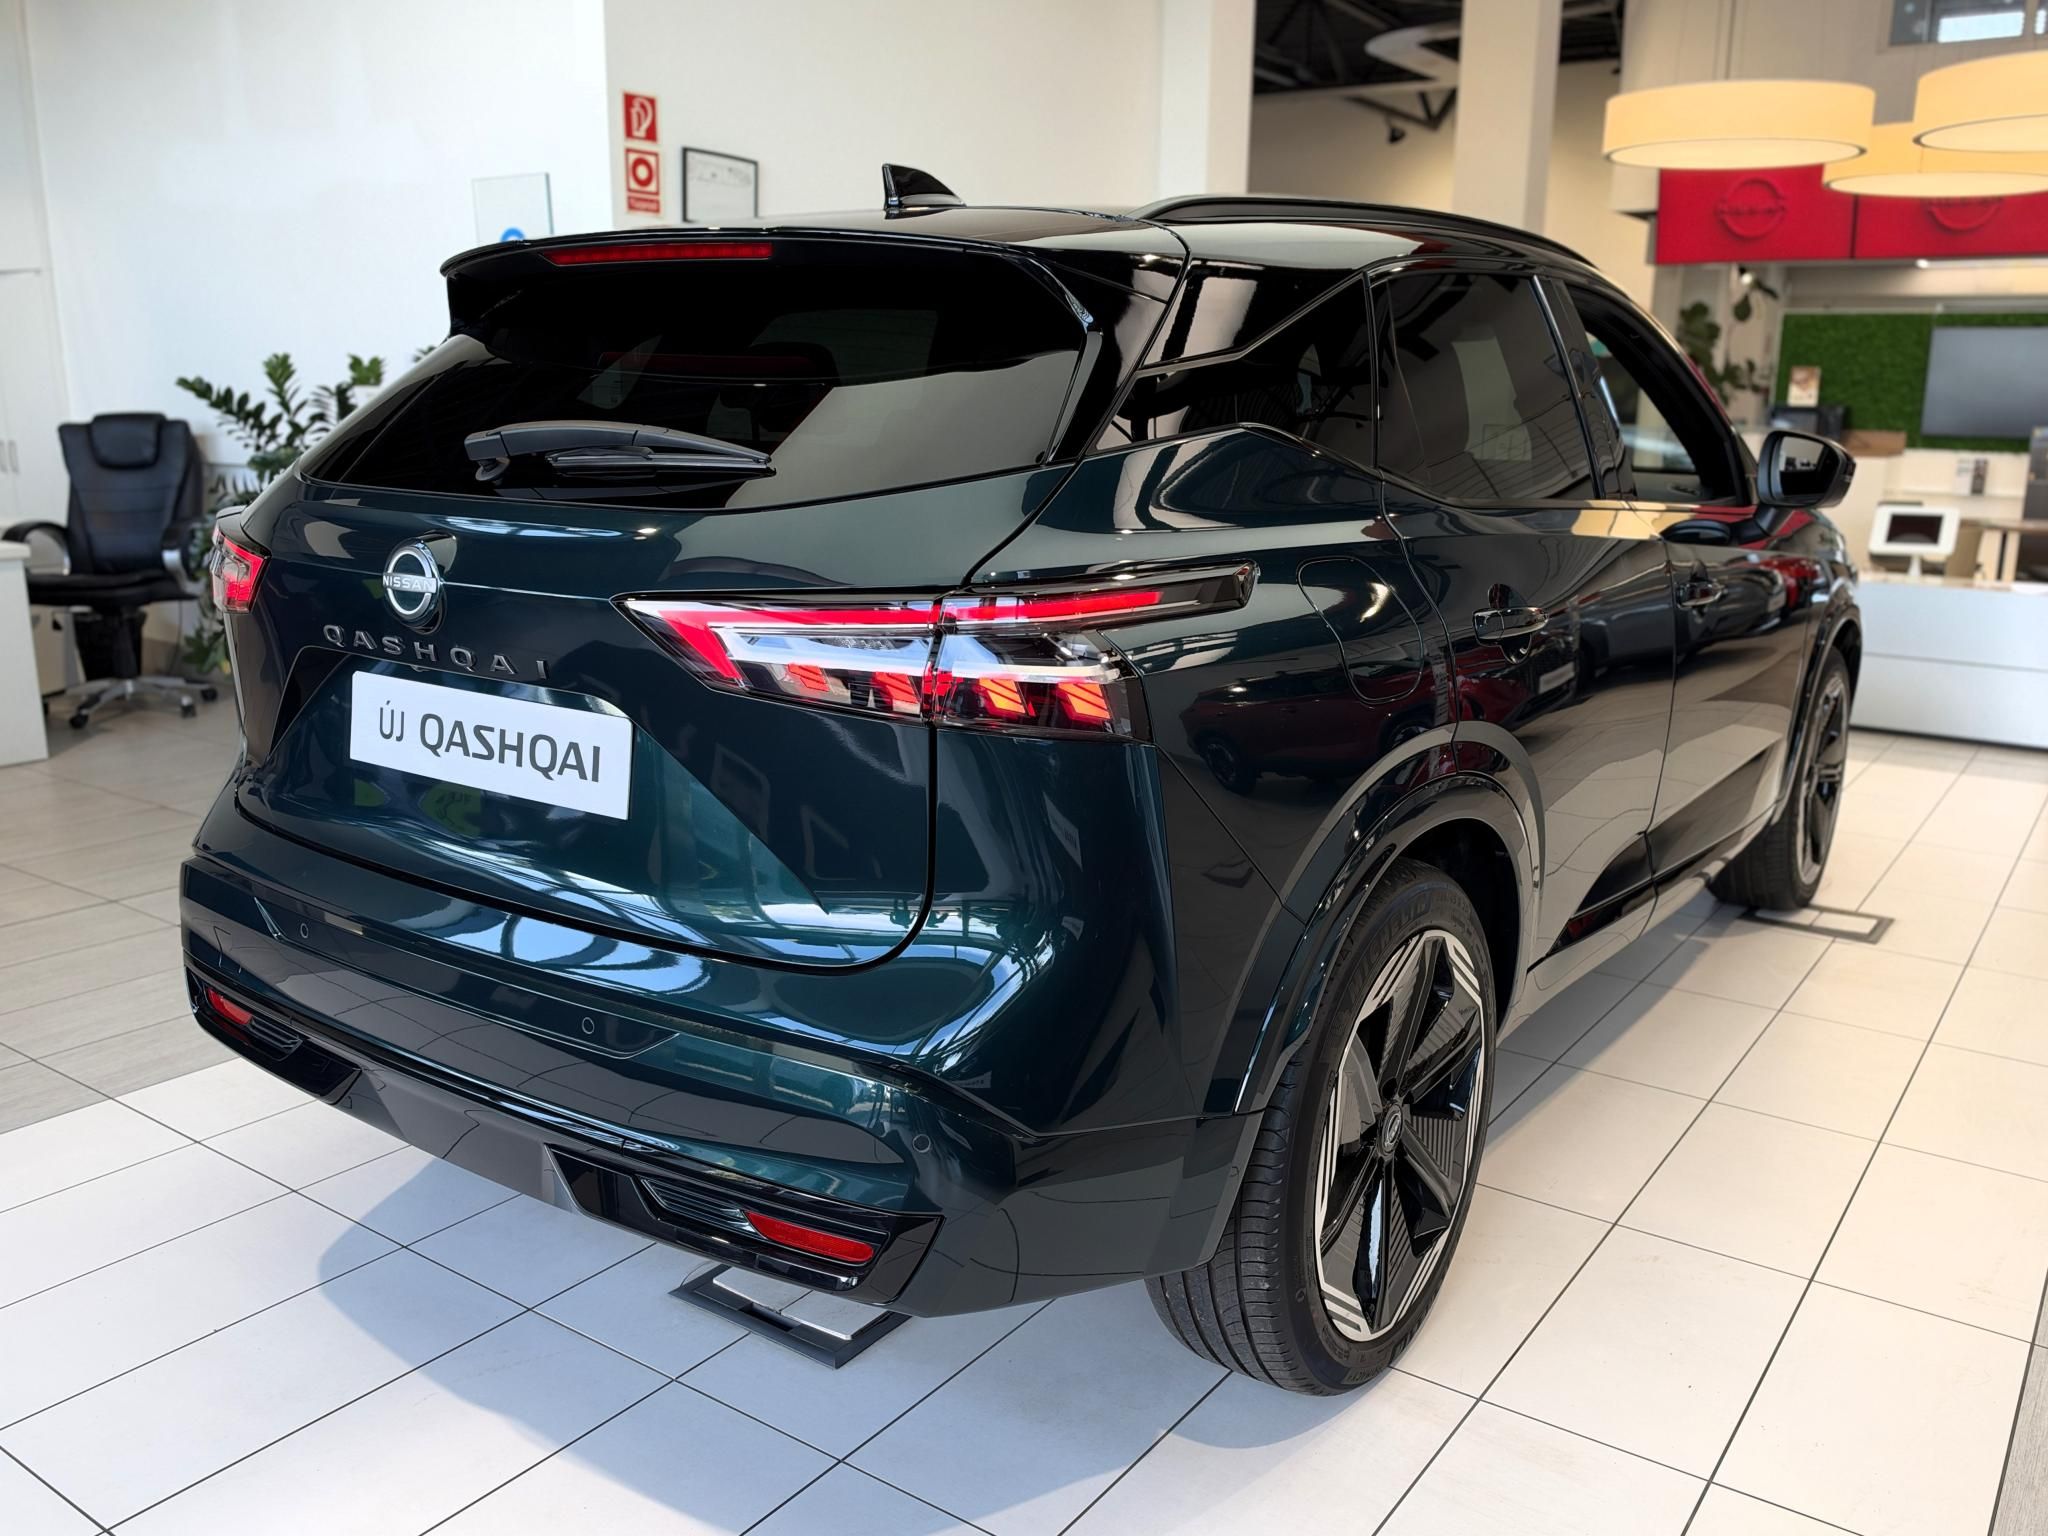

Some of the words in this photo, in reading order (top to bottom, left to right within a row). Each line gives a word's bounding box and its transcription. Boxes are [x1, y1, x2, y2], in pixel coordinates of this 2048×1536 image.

[383, 575, 436, 592] NISSAN
[323, 624, 549, 680] QASHQAI
[379, 700, 405, 742] ÚJ
[419, 714, 601, 782] QASHQAI
